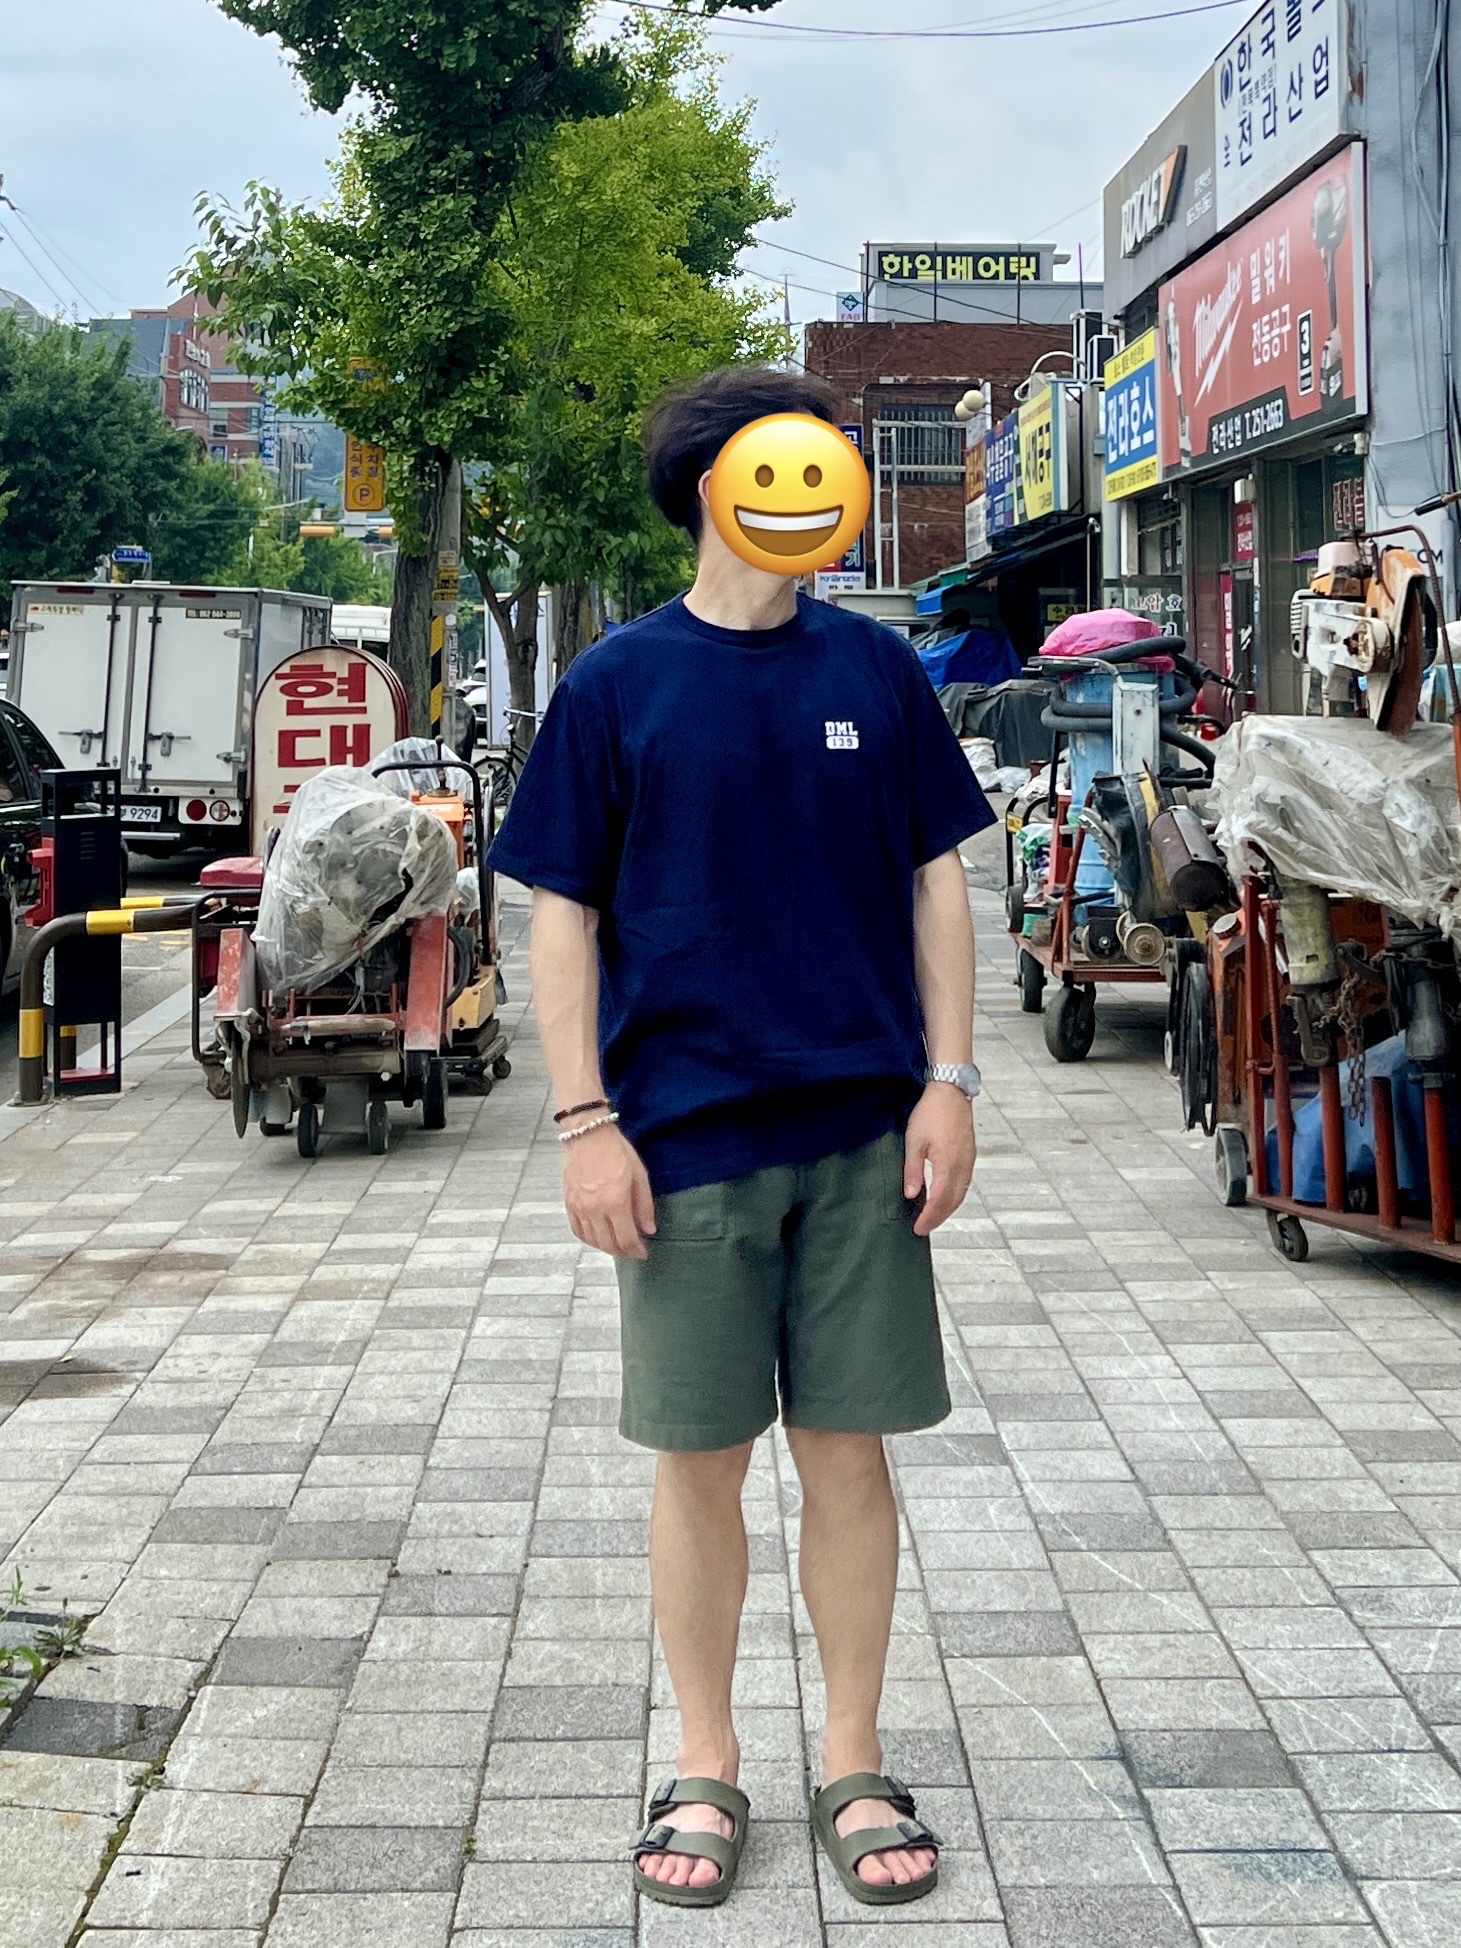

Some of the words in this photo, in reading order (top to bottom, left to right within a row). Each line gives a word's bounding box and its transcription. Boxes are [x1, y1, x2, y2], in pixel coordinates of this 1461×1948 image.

[1237, 0, 1326, 93] 한국볼
[1239, 35, 1329, 167] 전라산업
[882, 253, 1036, 281] 한일베어링
[1250, 226, 1291, 305] 밀워키
[1251, 303, 1291, 367] 전동공구
[1300, 320, 1310, 355] 3
[1107, 375, 1155, 465] 전라호스
[359, 488, 371, 501] P
[272, 662, 371, 814] 현대
[130, 807, 158, 820] 9294
